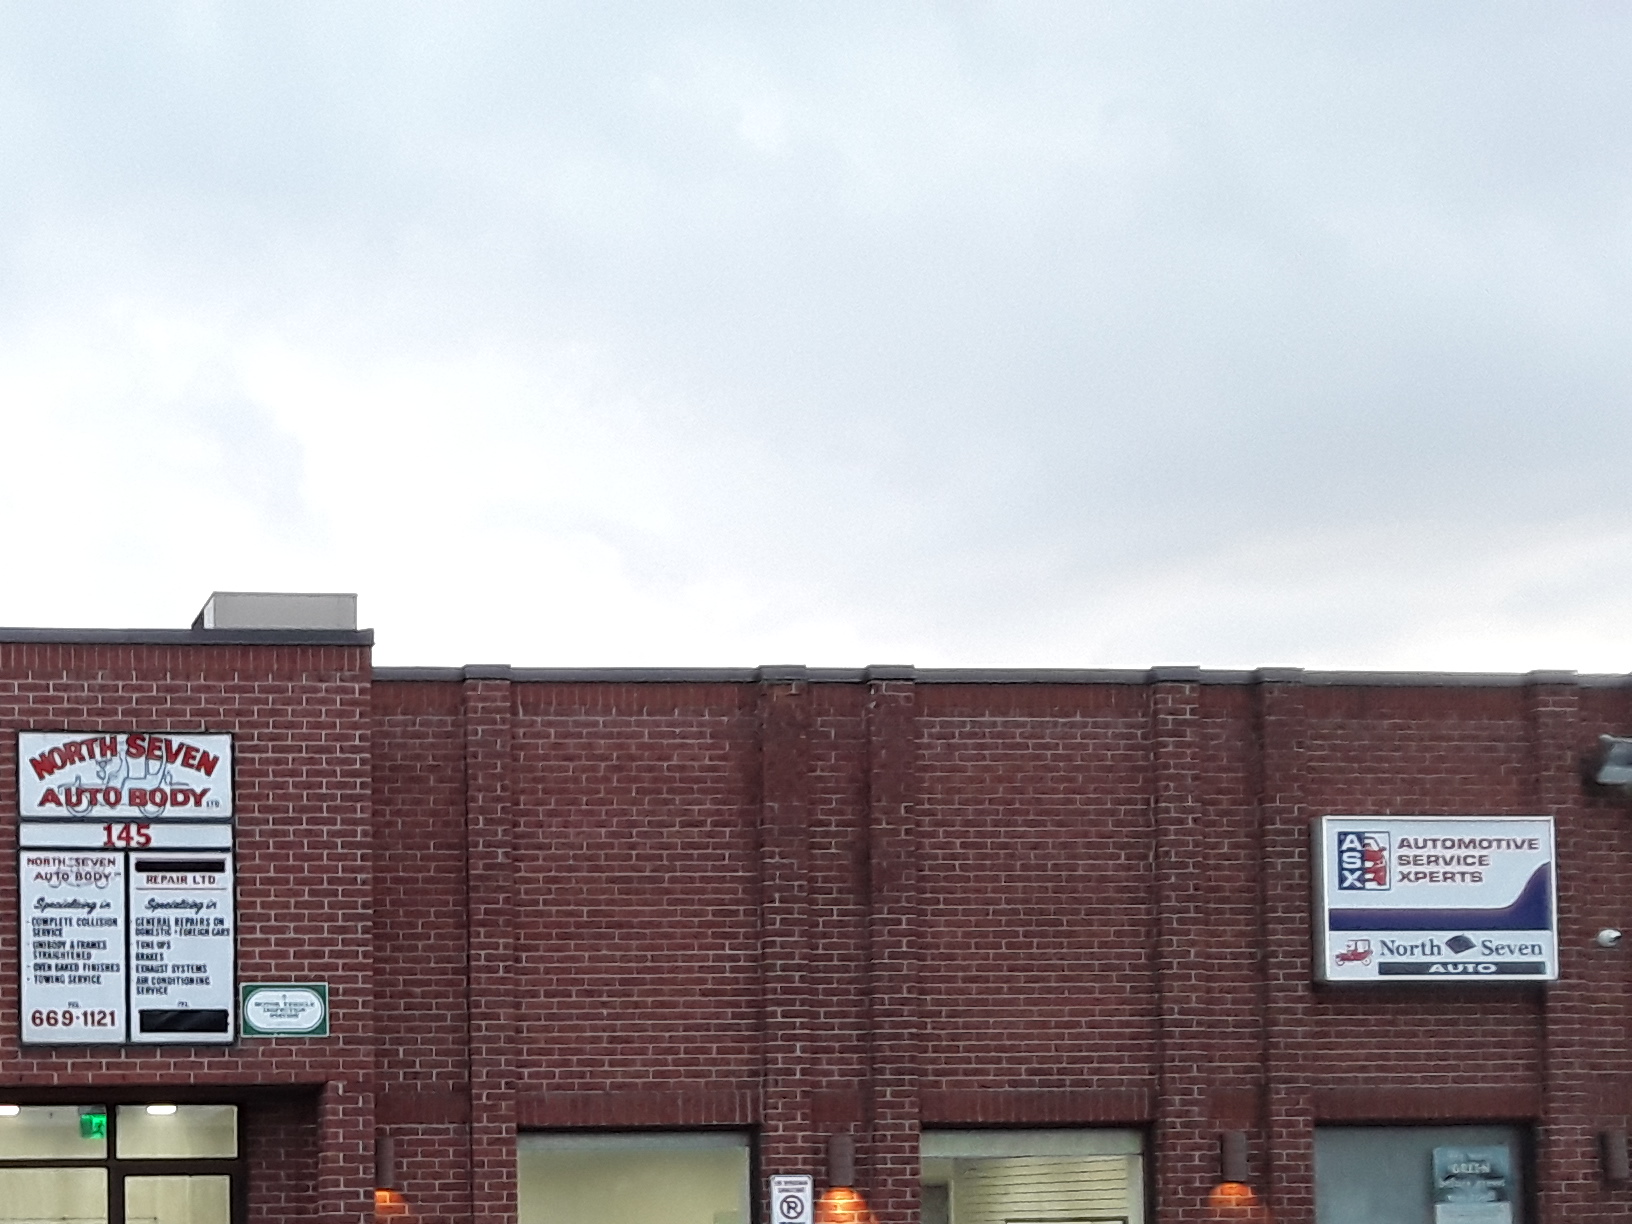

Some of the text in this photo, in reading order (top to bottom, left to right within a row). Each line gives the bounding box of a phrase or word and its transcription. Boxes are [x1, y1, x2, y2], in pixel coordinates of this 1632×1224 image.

[29, 733, 219, 781] NORTH SEVEN
[38, 788, 122, 807] AUTO
[128, 788, 211, 807] BODY
[103, 823, 152, 848] 145
[1397, 837, 1540, 851] AUTOMOTIVE
[27, 857, 116, 868] NORTH SEVEN
[1397, 854, 1490, 867] SERVICE
[34, 871, 69, 882] AUTO
[75, 872, 111, 882] BODY
[146, 875, 216, 885] REPAIR LTD
[1397, 870, 1484, 884] XPERTS
[1380, 938, 1542, 956] North Seven
[1429, 963, 1497, 974] AUTO
